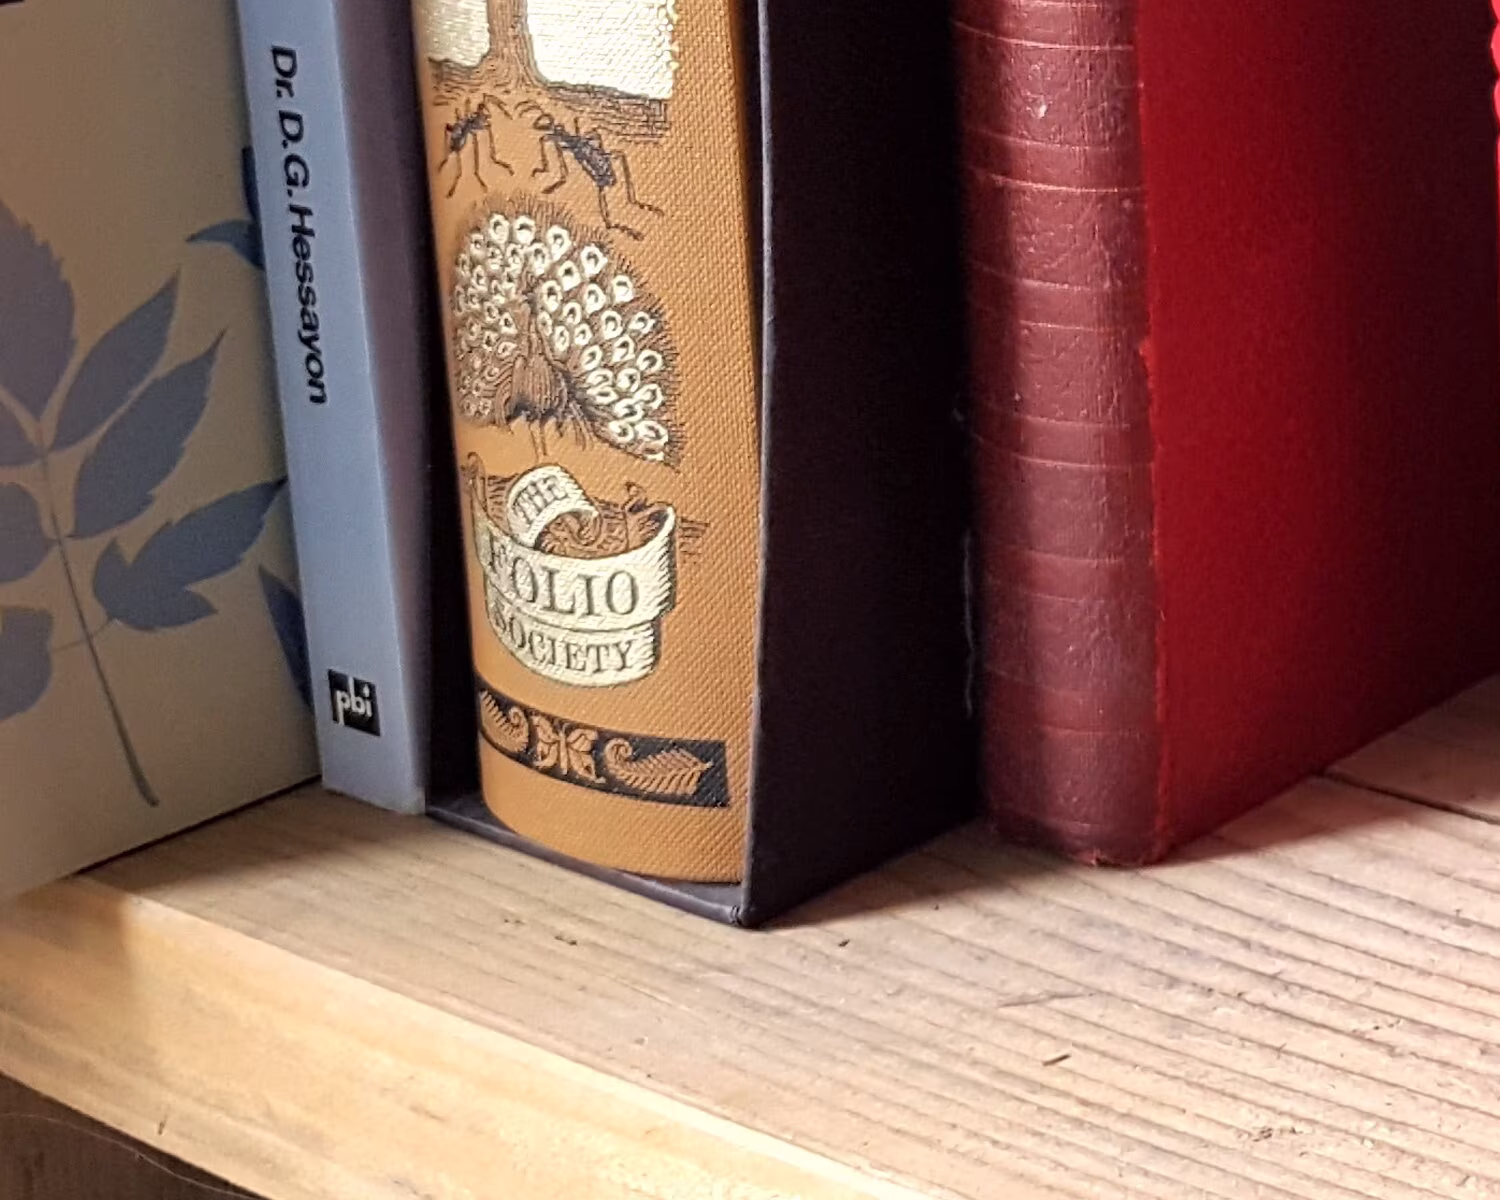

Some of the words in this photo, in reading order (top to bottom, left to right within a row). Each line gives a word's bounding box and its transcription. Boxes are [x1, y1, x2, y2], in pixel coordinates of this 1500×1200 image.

[271, 44, 298, 99] Dr.
[488, 522, 640, 617] FOLIO
[491, 600, 638, 675] SOCIETY
[335, 675, 374, 727] pbi
